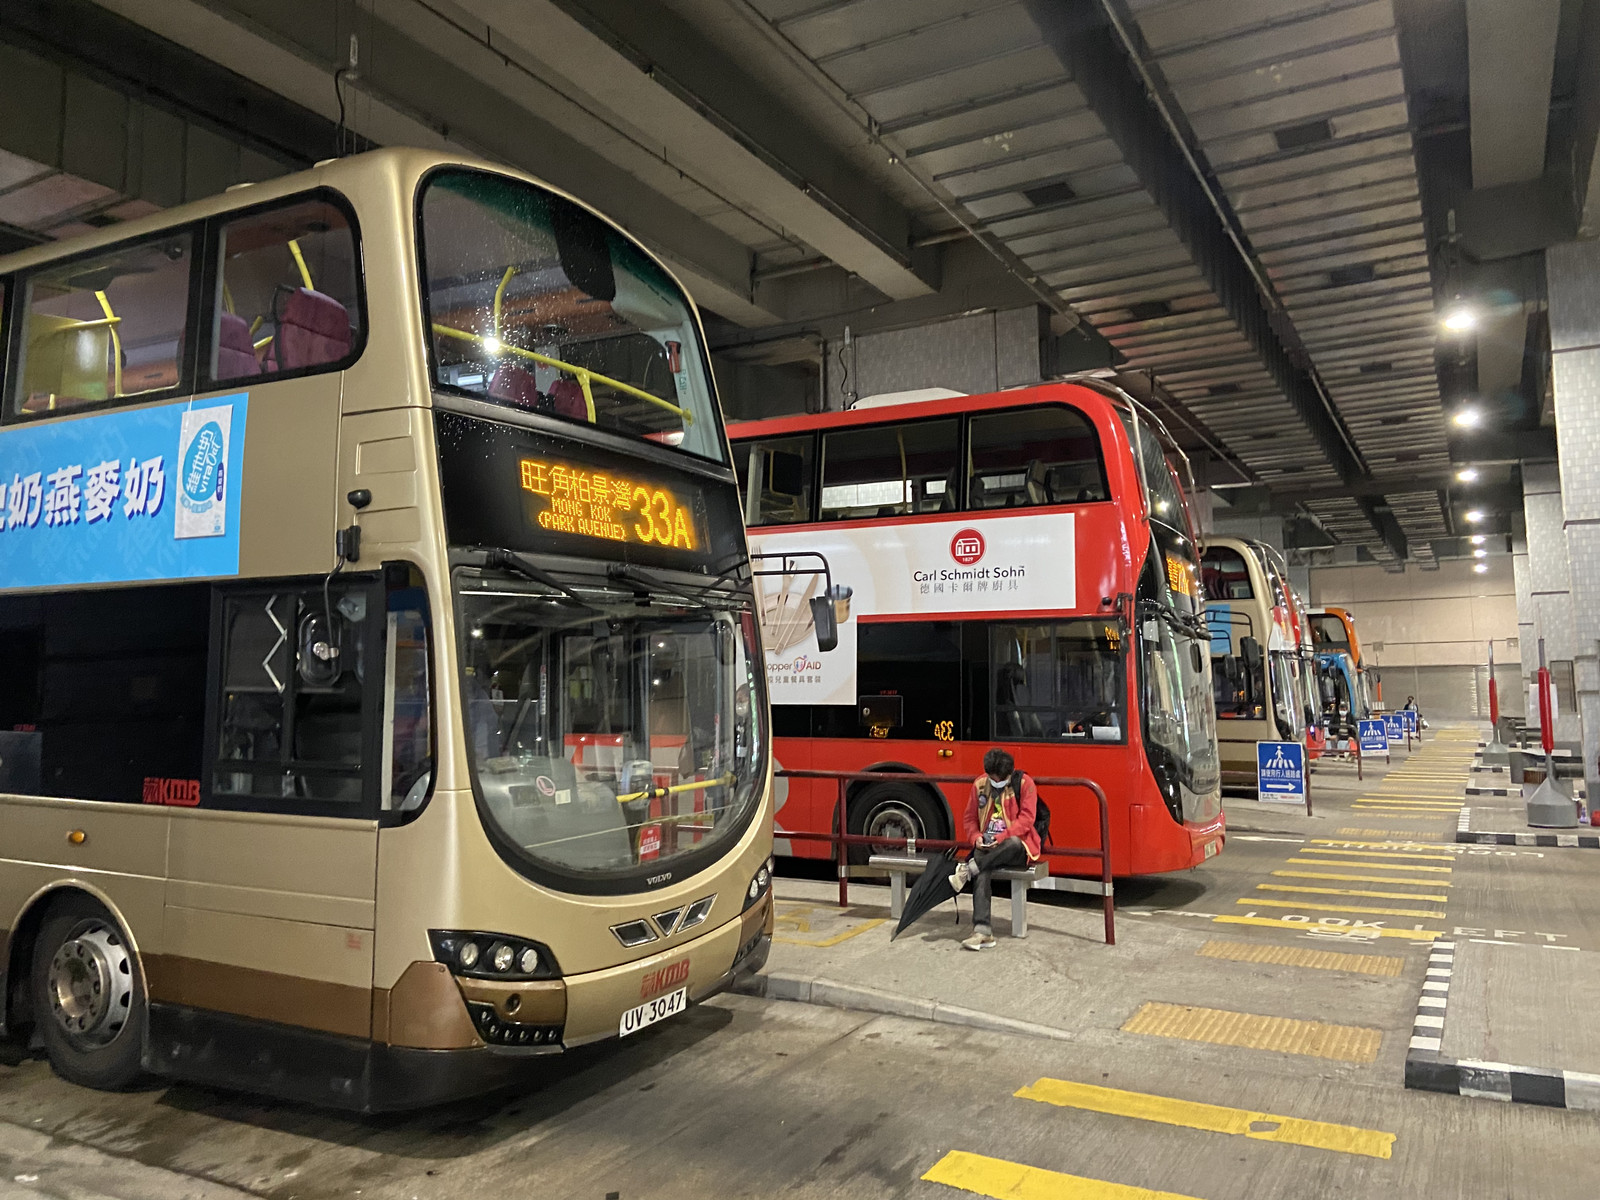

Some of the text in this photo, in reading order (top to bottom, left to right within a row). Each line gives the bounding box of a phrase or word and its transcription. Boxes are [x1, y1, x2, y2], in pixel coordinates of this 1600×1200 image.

[186, 429, 214, 494] 維他奶
[520, 460, 632, 511] 旺角柏景灣
[551, 497, 611, 522] MONG KOK
[632, 486, 692, 549] 33A
[538, 511, 627, 541] (PARK AVENUE)
[913, 570, 937, 582] Carl
[940, 567, 990, 581] Schmidt
[806, 661, 822, 670] AID
[159, 778, 200, 806] KMB
[646, 872, 672, 885] VOLVO
[1243, 911, 1568, 942] LOOK LEFT
[654, 958, 690, 991] KMB
[625, 991, 683, 1031] UV 3047
